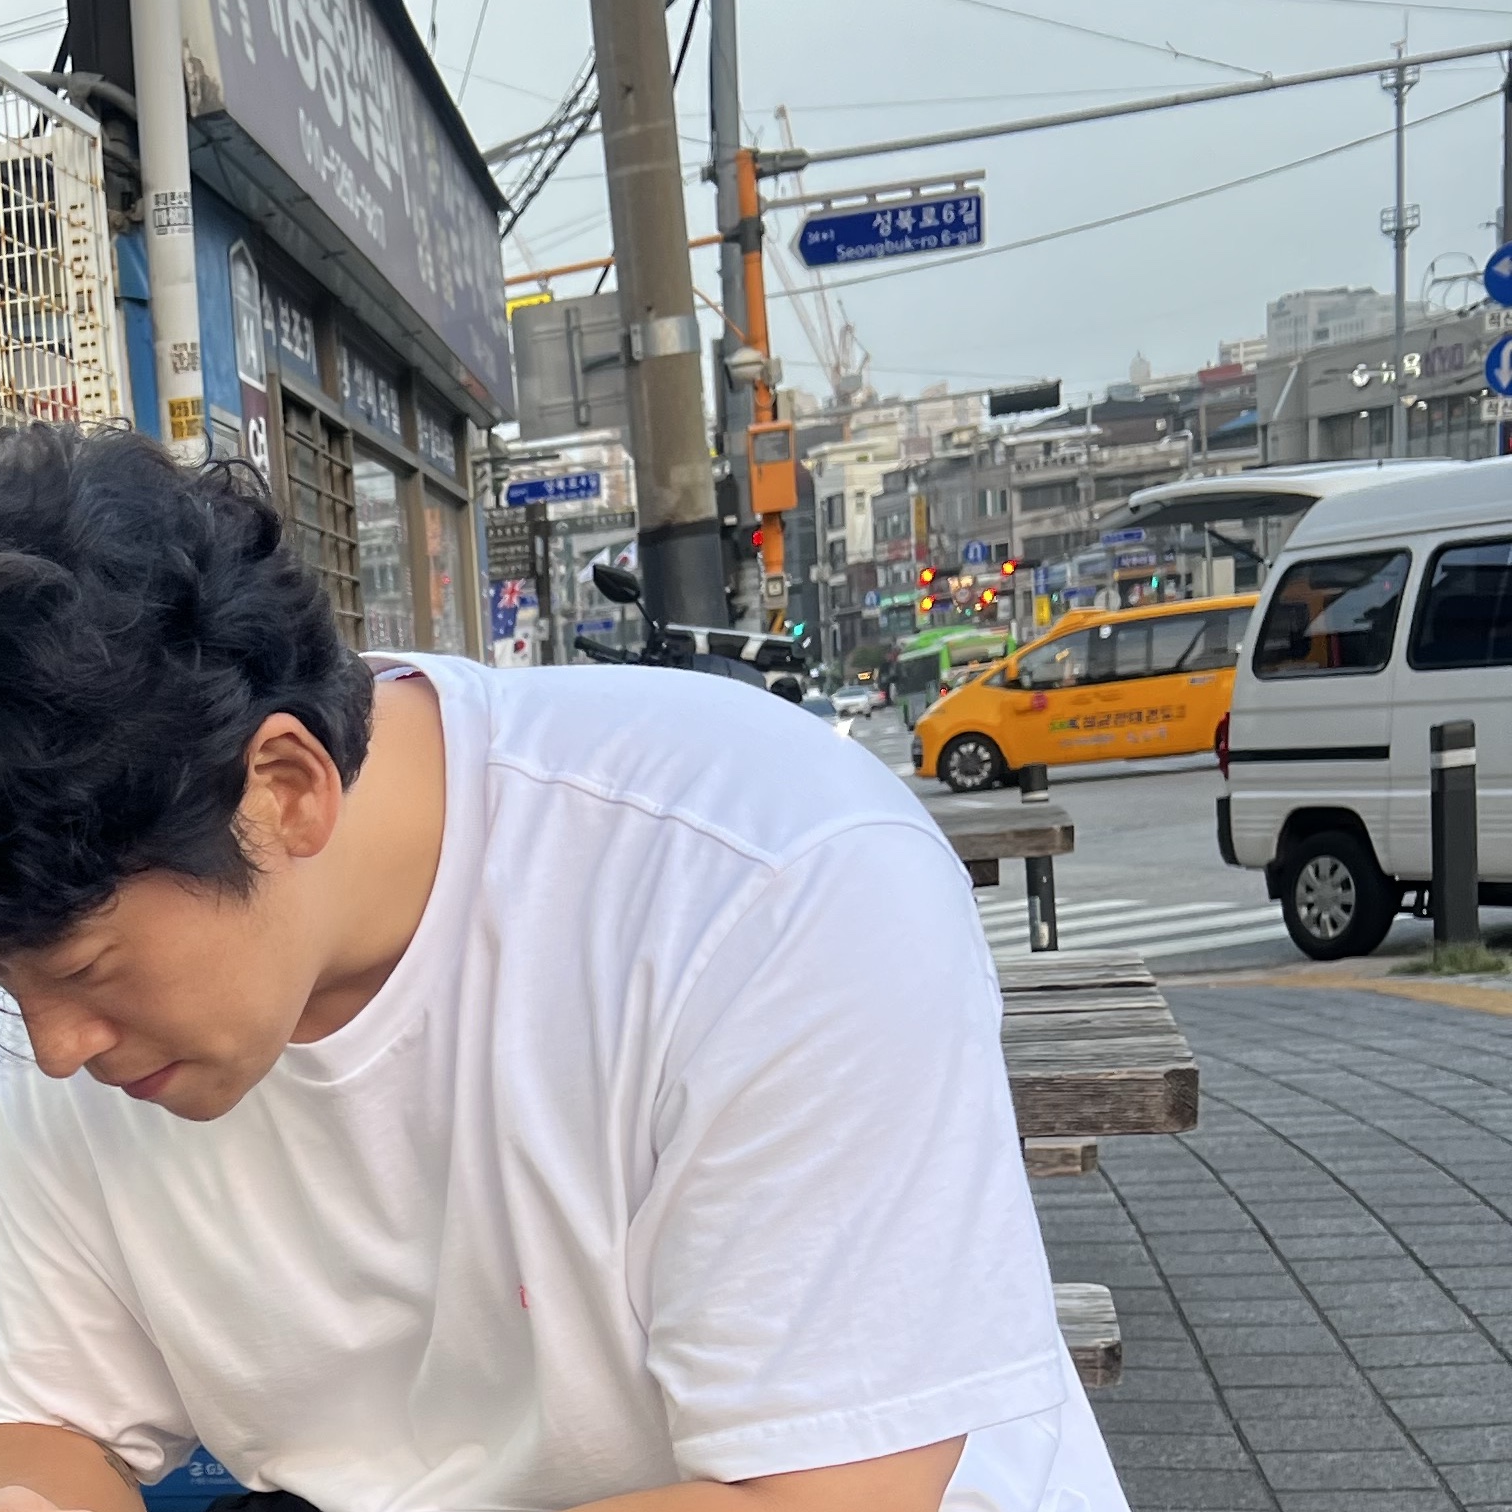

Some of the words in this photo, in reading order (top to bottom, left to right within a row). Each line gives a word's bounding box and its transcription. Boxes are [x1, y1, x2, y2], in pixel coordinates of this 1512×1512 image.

[872, 196, 977, 238] 성북로6길
[837, 234, 939, 261] Seongbuk-ro
[940, 225, 979, 247] 6-gil
